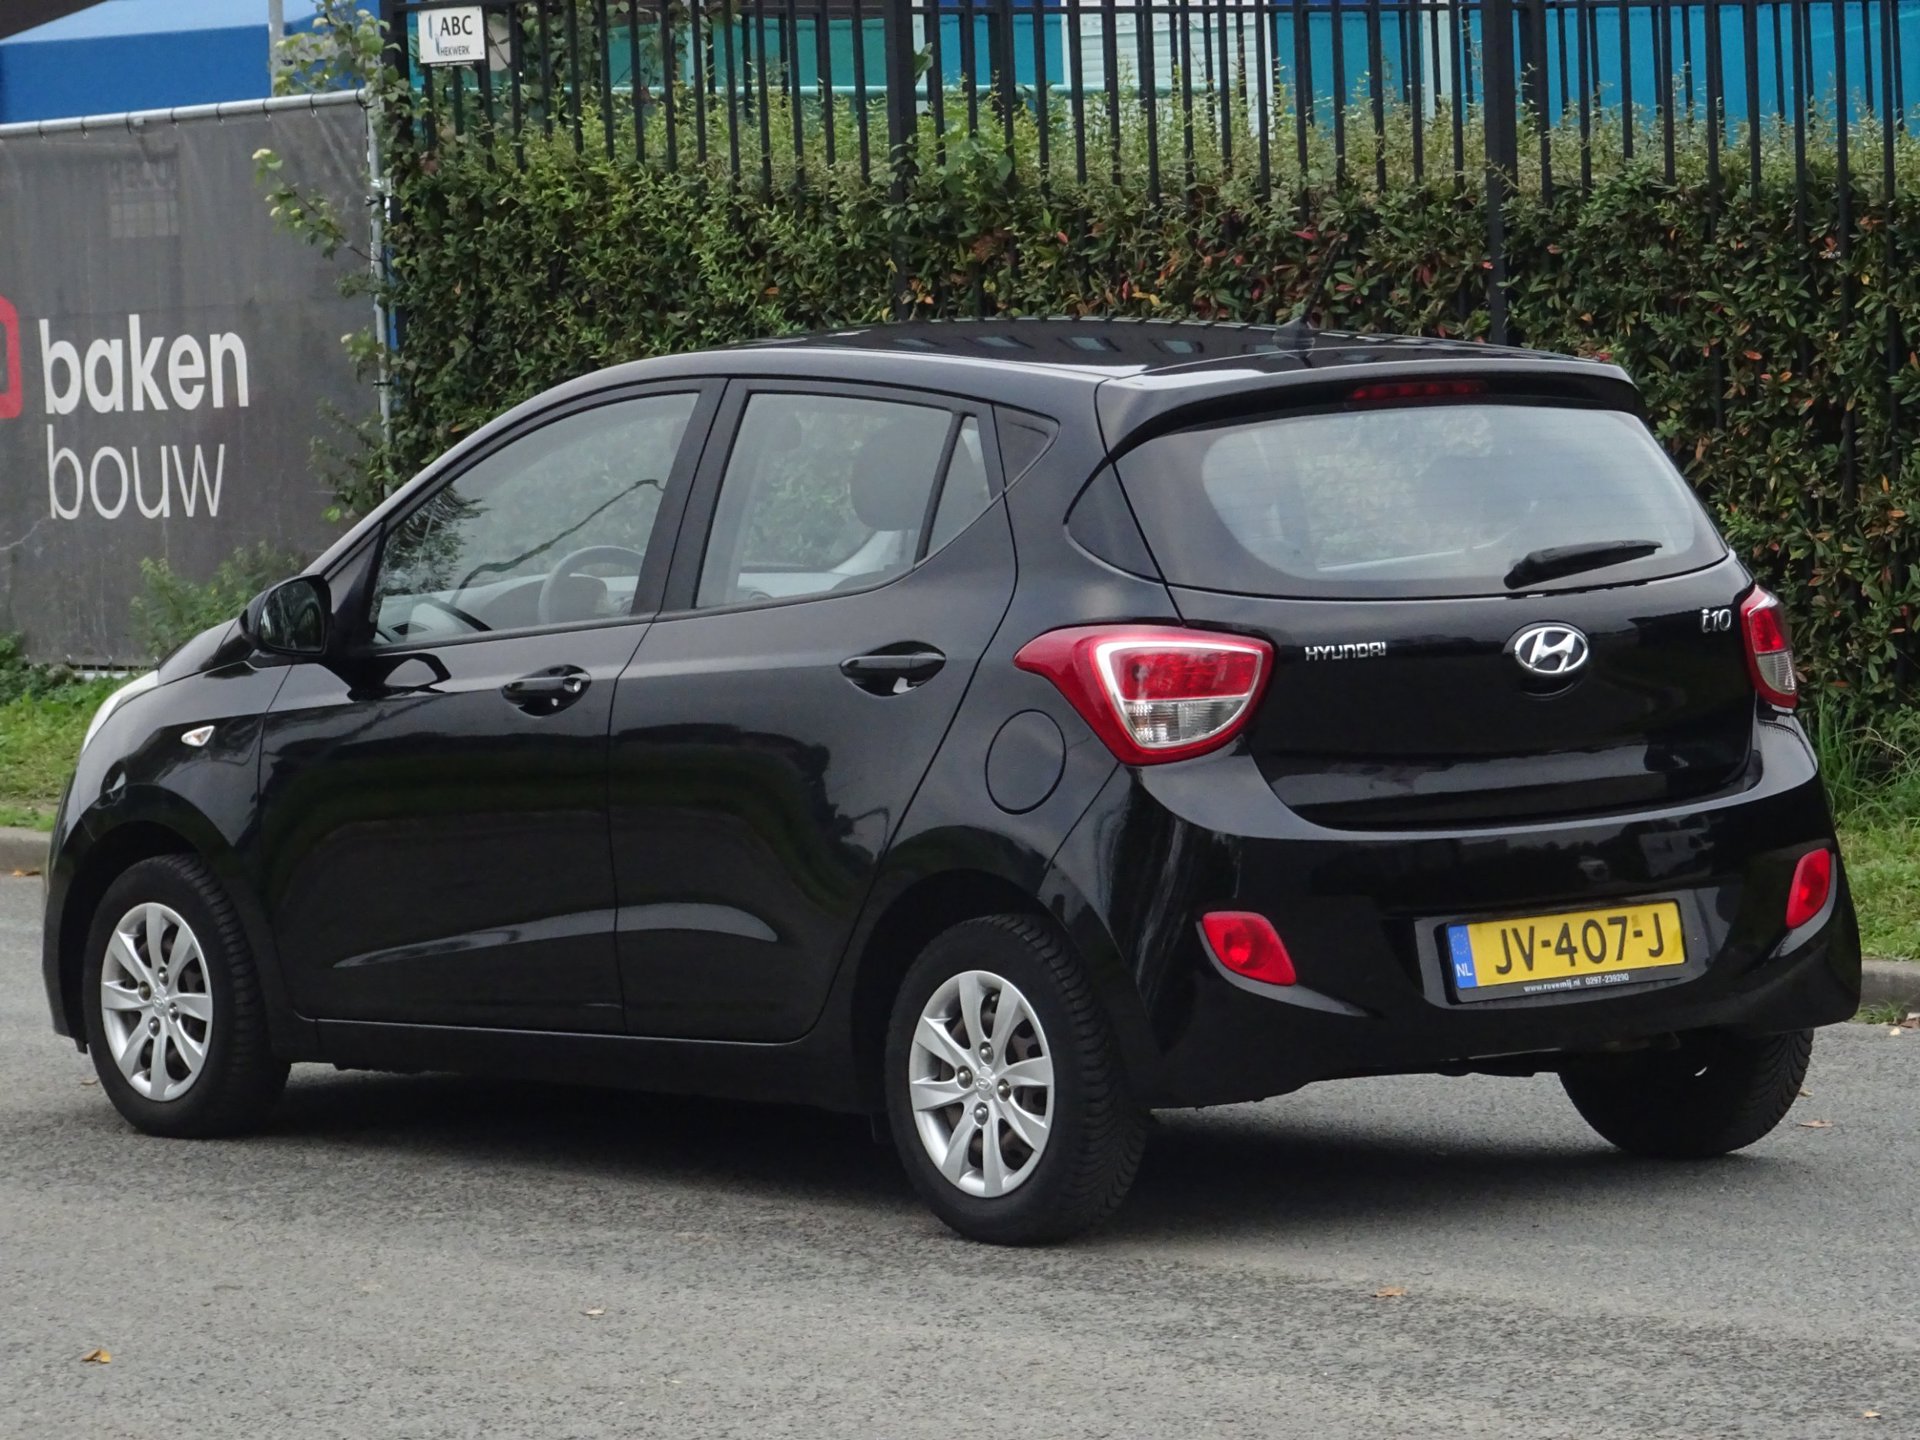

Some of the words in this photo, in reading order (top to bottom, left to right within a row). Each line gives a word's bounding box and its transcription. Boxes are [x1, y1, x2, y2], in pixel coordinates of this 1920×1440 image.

[440, 15, 473, 37] ABC
[440, 45, 471, 57] HEKWERK
[39, 314, 249, 415] baken
[47, 424, 225, 520] bouw
[1701, 608, 1732, 633] i10
[1304, 641, 1387, 661] HYUNDAI
[1495, 912, 1666, 975] JV-407-J
[1456, 963, 1474, 977] NL
